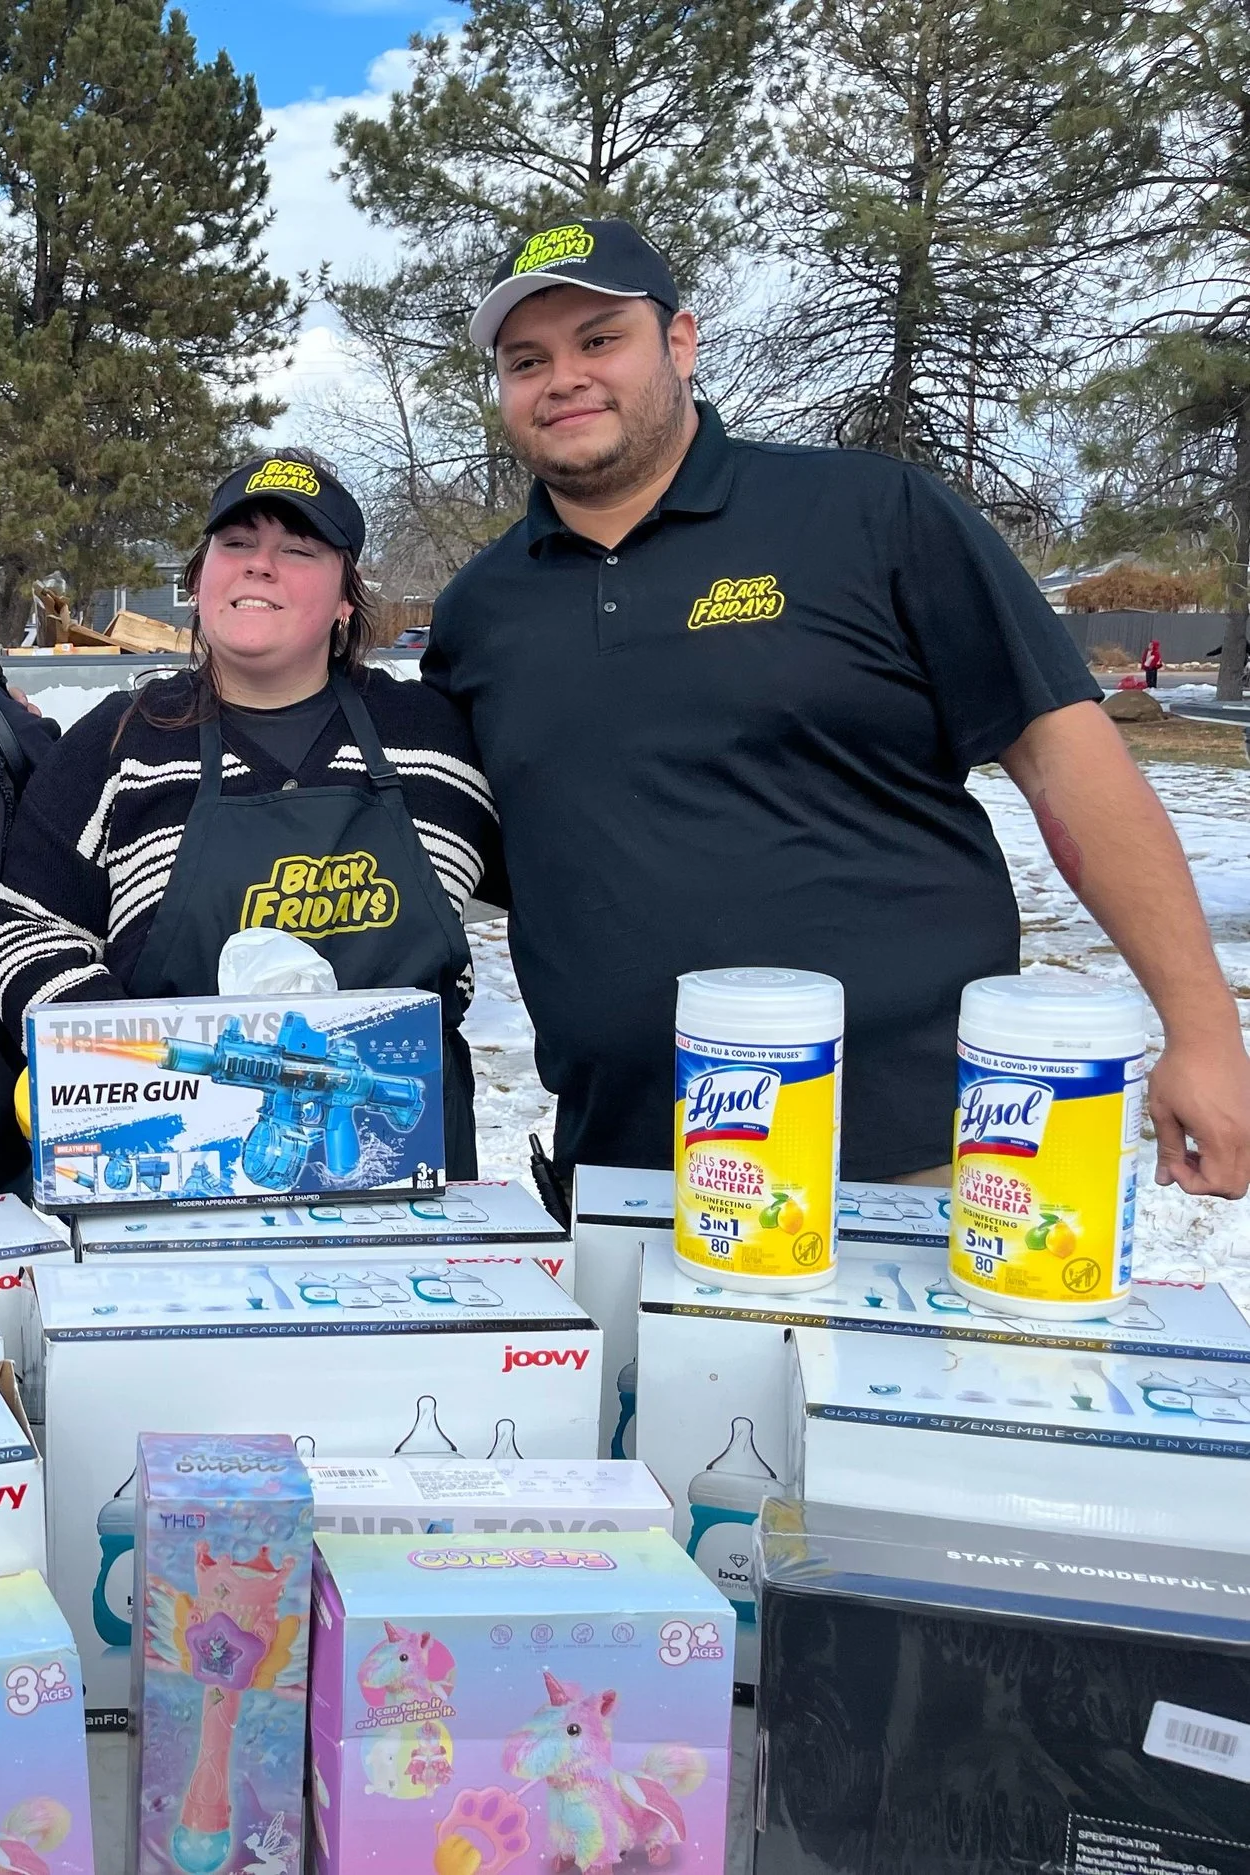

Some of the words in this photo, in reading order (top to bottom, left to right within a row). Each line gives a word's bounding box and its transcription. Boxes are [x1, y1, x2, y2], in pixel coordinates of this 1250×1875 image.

[528, 227, 579, 255] BLACK
[265, 463, 312, 479] BLACK
[713, 580, 772, 603] BLACK
[280, 860, 368, 895] BLACK
[50, 1015, 184, 1055] TRENDY
[195, 1013, 282, 1041] TOYS
[710, 1047, 723, 1055] FLU
[731, 1049, 767, 1059] COVID-19
[1000, 1060, 1038, 1073] COVID-19
[51, 1082, 144, 1106] WATER
[144, 1079, 199, 1102] GUN
[688, 1075, 771, 1129] Lysol
[961, 1087, 1044, 1142] Lysol
[689, 1152, 715, 1168] KILLS
[719, 1158, 764, 1174] 99.9%
[689, 1163, 703, 1174] OF
[705, 1166, 764, 1184] VIRUSES
[416, 1178, 434, 1190] AGES
[697, 1176, 762, 1196] BACTERIA
[959, 1175, 971, 1188] OF
[972, 1180, 1032, 1204] VIRUSES
[960, 1165, 982, 1180] KILLS
[984, 1173, 1032, 1192] 99.9%
[176, 1200, 205, 1208] MODERN
[205, 1197, 248, 1206] APPEARANCE
[262, 1195, 294, 1203] UNIQUELY
[294, 1193, 320, 1202] SHAPED
[695, 1193, 752, 1210] DISINFECTING
[965, 1189, 1030, 1215] BACTERIA
[708, 1204, 734, 1215] WIPES
[963, 1207, 1018, 1229] DISINFECTING
[974, 1219, 999, 1234] WIPES
[710, 1239, 730, 1255] 80
[975, 1255, 993, 1274] 80
[58, 1330, 102, 1338] GLASS
[106, 1329, 137, 1337] GIFT
[333, 1322, 431, 1332] VERRE/JUEGO
[704, 1308, 736, 1317] GIFT
[955, 1330, 1071, 1346] VERRE/JUEGO
[1101, 1342, 1169, 1354] REGALO
[502, 1345, 590, 1373] joovy
[823, 1407, 880, 1421] GLASS
[885, 1414, 925, 1426] GIFT
[930, 1416, 1150, 1446] SET/ENSEMBLE-CADEAU
[175, 1460, 287, 1475] Bubble
[414, 1550, 513, 1568] CUTE
[517, 1549, 611, 1569] PETS
[946, 1550, 1024, 1568] START
[1033, 1560, 1052, 1570] A
[1056, 1562, 1216, 1592] WONDERFUL
[658, 1620, 719, 1667] 3+
[690, 1646, 723, 1660] AGES
[5, 1661, 67, 1716] 3+
[40, 1687, 72, 1704] AGES
[355, 1719, 377, 1731] out
[378, 1713, 403, 1726] and
[404, 1706, 439, 1722] clean
[440, 1705, 456, 1718] it.
[367, 1707, 374, 1719] I
[377, 1706, 398, 1718] can
[400, 1700, 429, 1713] take
[431, 1697, 443, 1710] it
[1078, 1829, 1161, 1852] SPECIFICATION
[1075, 1853, 1137, 1873] Manufacture
[1076, 1843, 1115, 1858] Product
[1116, 1851, 1148, 1864] Name:
[1150, 1856, 1195, 1873] Massage
